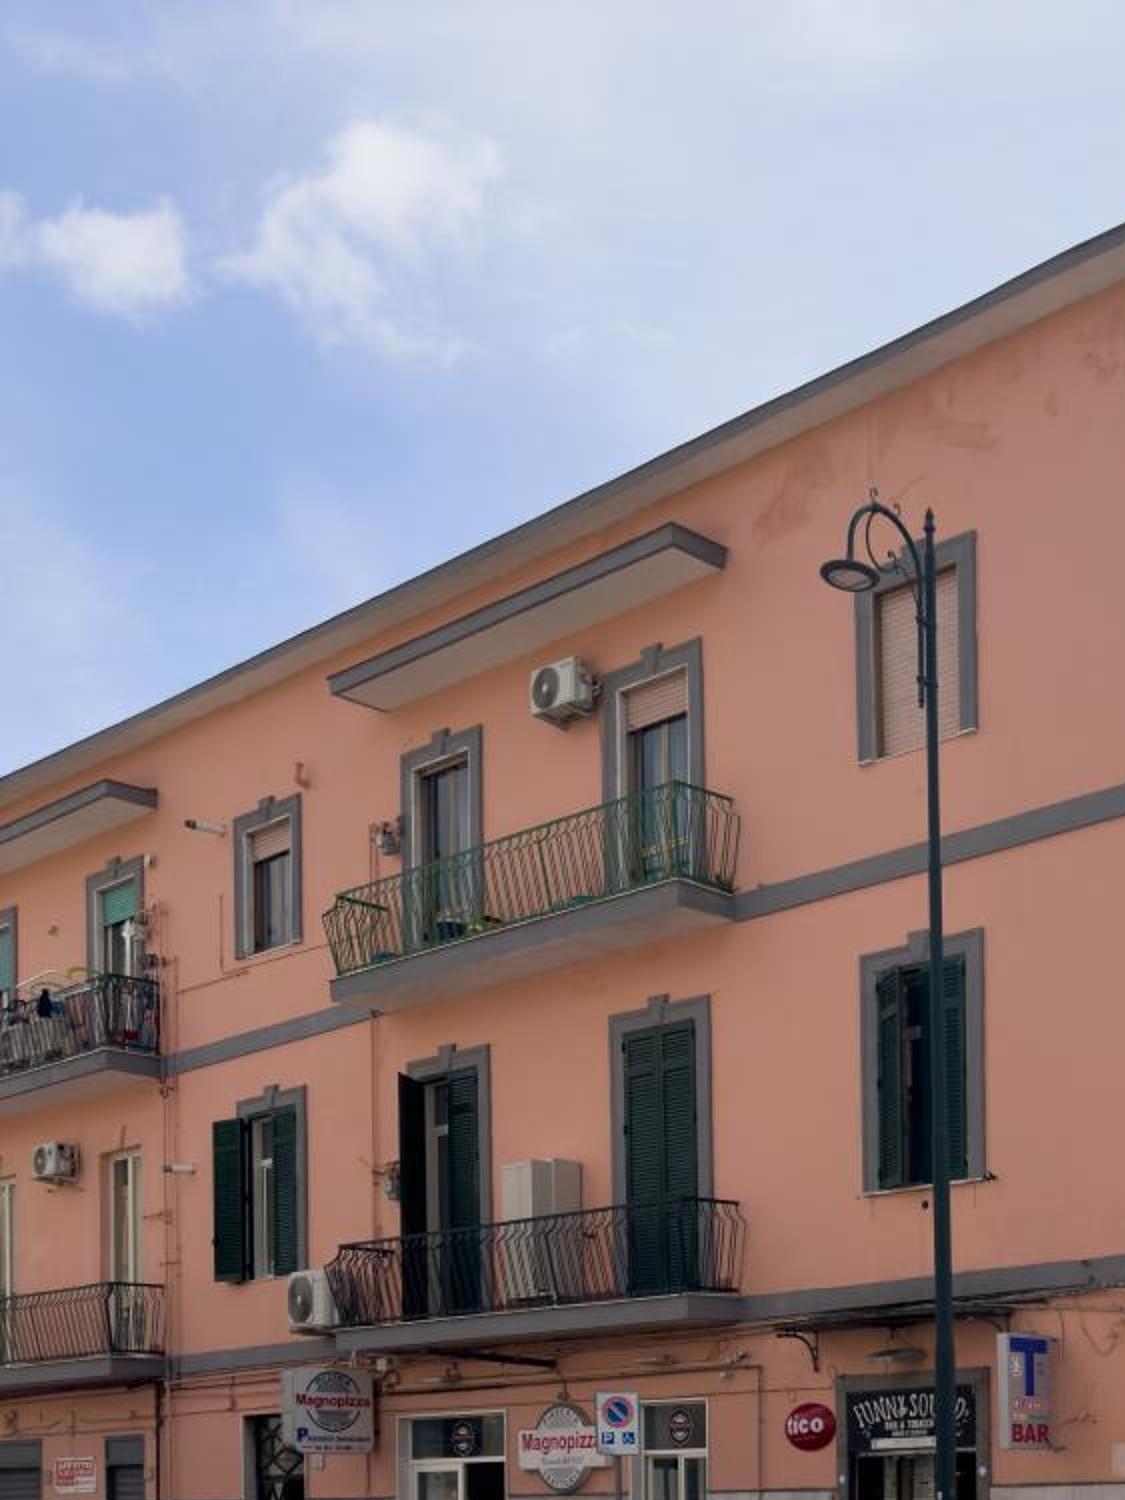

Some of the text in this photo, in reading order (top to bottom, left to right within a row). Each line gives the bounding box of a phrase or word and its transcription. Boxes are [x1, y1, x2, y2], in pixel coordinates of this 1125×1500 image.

[296, 1393, 371, 1409] Magnopizza
[853, 1395, 908, 1429] FUNNY
[521, 1432, 598, 1455] Magnopizz
[1011, 1423, 1050, 1443] BAR
